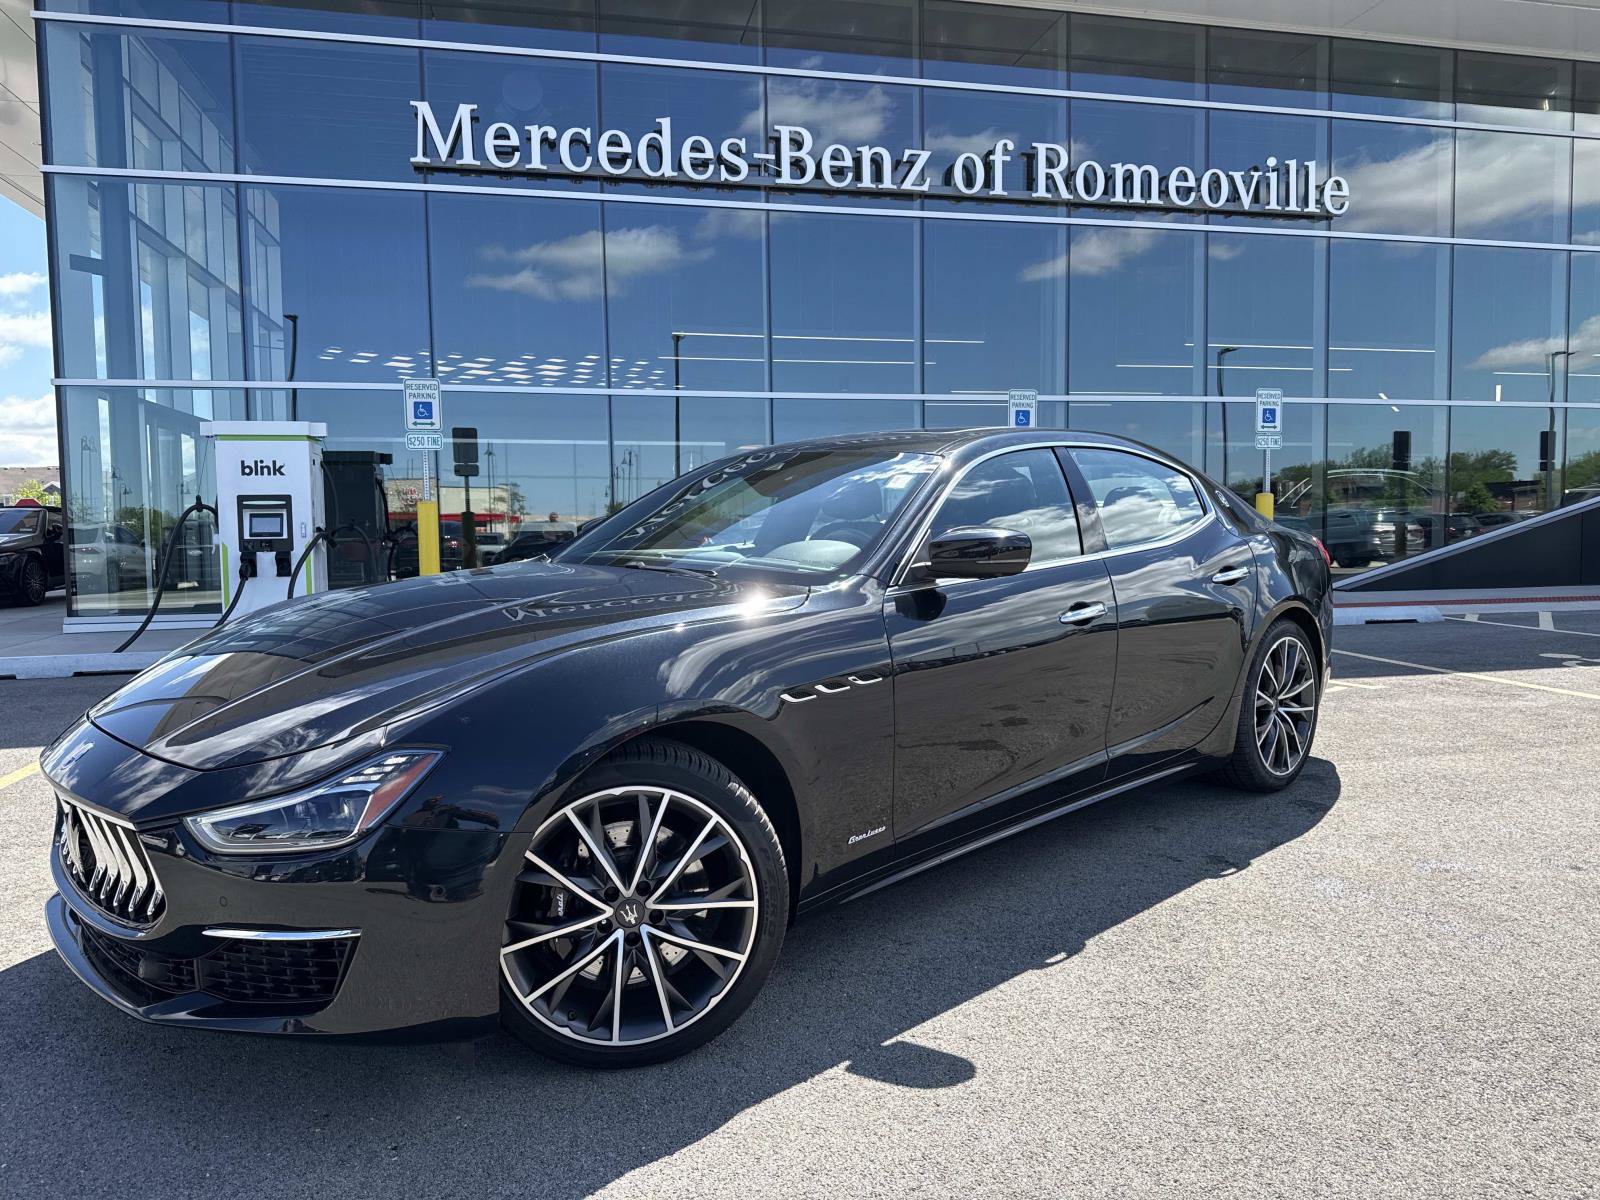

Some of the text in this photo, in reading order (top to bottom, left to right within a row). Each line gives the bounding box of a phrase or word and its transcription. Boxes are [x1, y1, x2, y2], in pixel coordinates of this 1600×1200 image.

[409, 100, 1351, 215] Mercedes-Benz of Romeoville
[406, 383, 438, 391] RESERVED
[408, 392, 437, 400] PARKING
[408, 436, 440, 446] $250 FINE
[240, 459, 286, 476] blink
